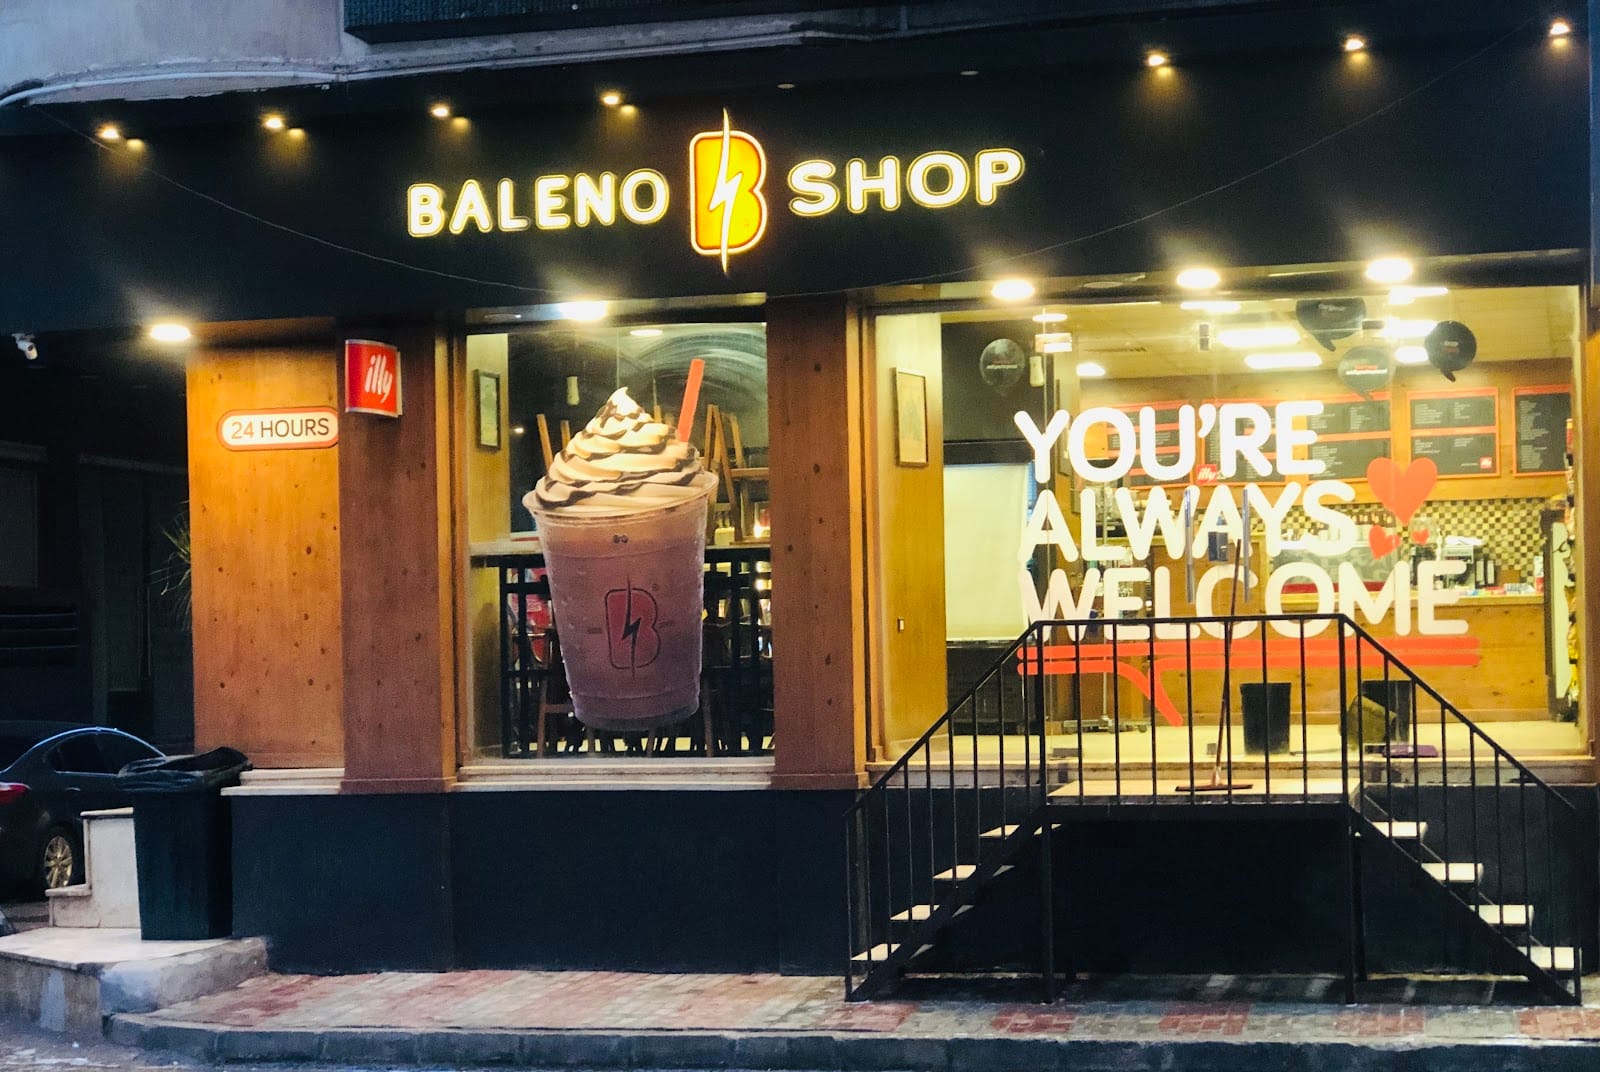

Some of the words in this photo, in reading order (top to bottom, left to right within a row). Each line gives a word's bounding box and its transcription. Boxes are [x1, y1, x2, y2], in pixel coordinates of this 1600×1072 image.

[407, 168, 670, 237] BALENO
[788, 148, 1026, 217] SHOP
[364, 354, 393, 404] illy
[231, 421, 255, 439] 24
[260, 418, 330, 438] HOURS
[1014, 400, 1326, 484] YOU'RE
[1018, 480, 1356, 562] ALWAYS
[1020, 561, 1470, 643] WELCOME
